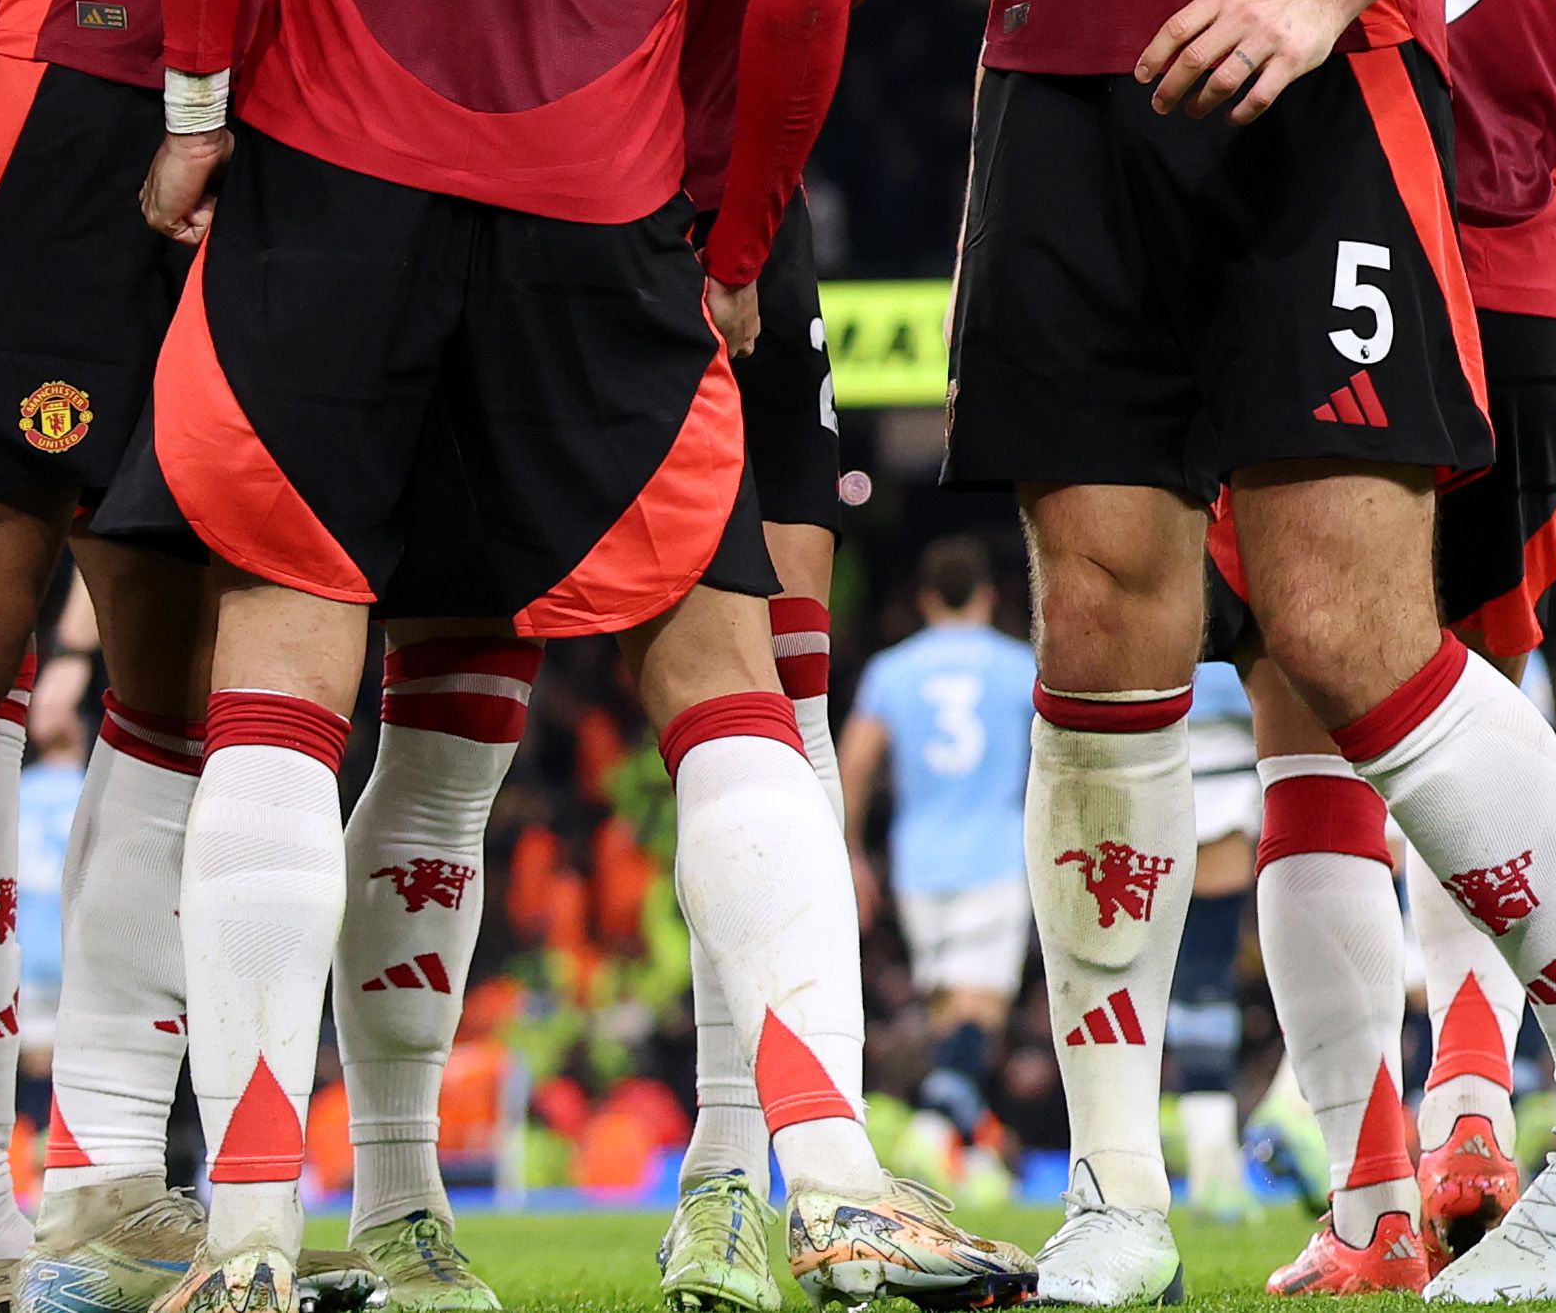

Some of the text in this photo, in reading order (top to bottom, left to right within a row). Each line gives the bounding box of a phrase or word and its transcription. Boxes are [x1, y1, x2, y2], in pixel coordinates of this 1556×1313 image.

[1327, 239, 1396, 365] 5
[26, 386, 85, 413] MANCHESTER
[37, 433, 79, 449] UNITED
[918, 672, 988, 777] 3
